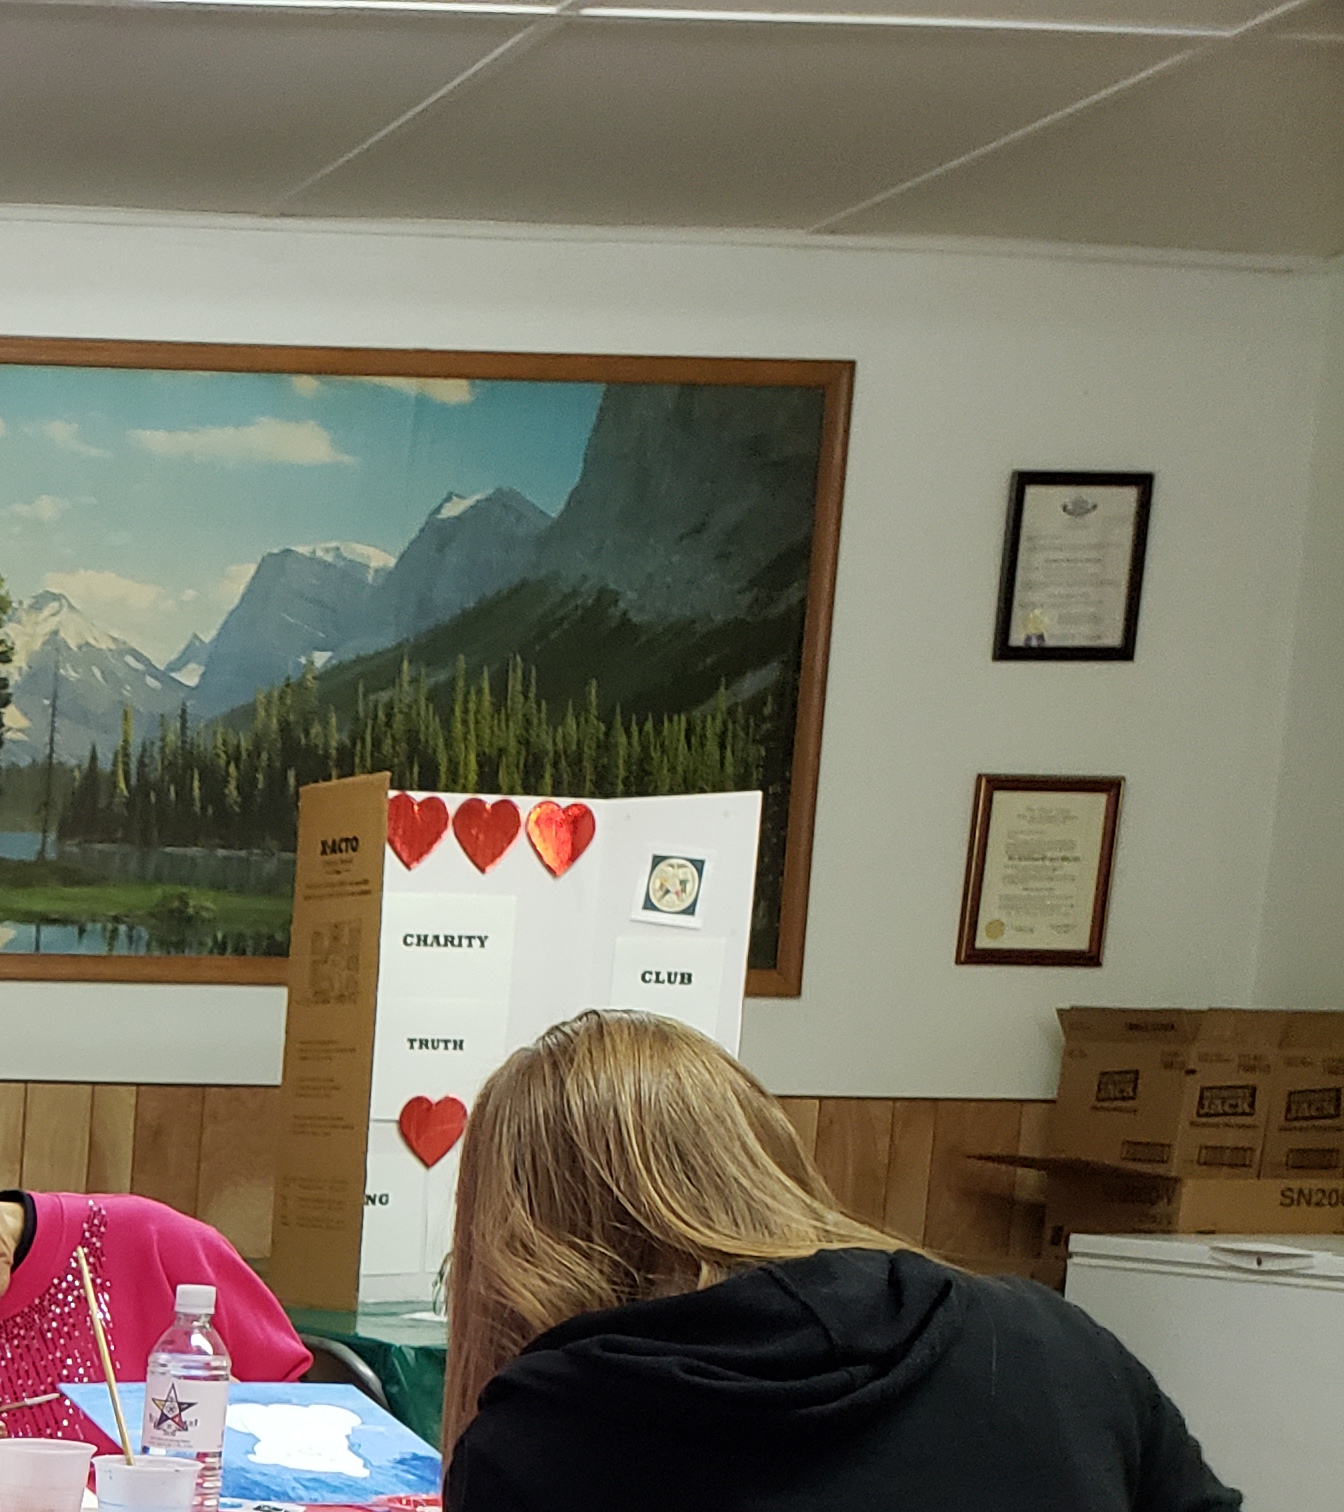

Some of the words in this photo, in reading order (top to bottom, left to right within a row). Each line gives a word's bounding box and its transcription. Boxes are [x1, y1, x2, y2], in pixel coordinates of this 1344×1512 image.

[402, 933, 488, 949] CHARITY
[640, 970, 693, 985] CLUB
[407, 1037, 464, 1051] TRUTH
